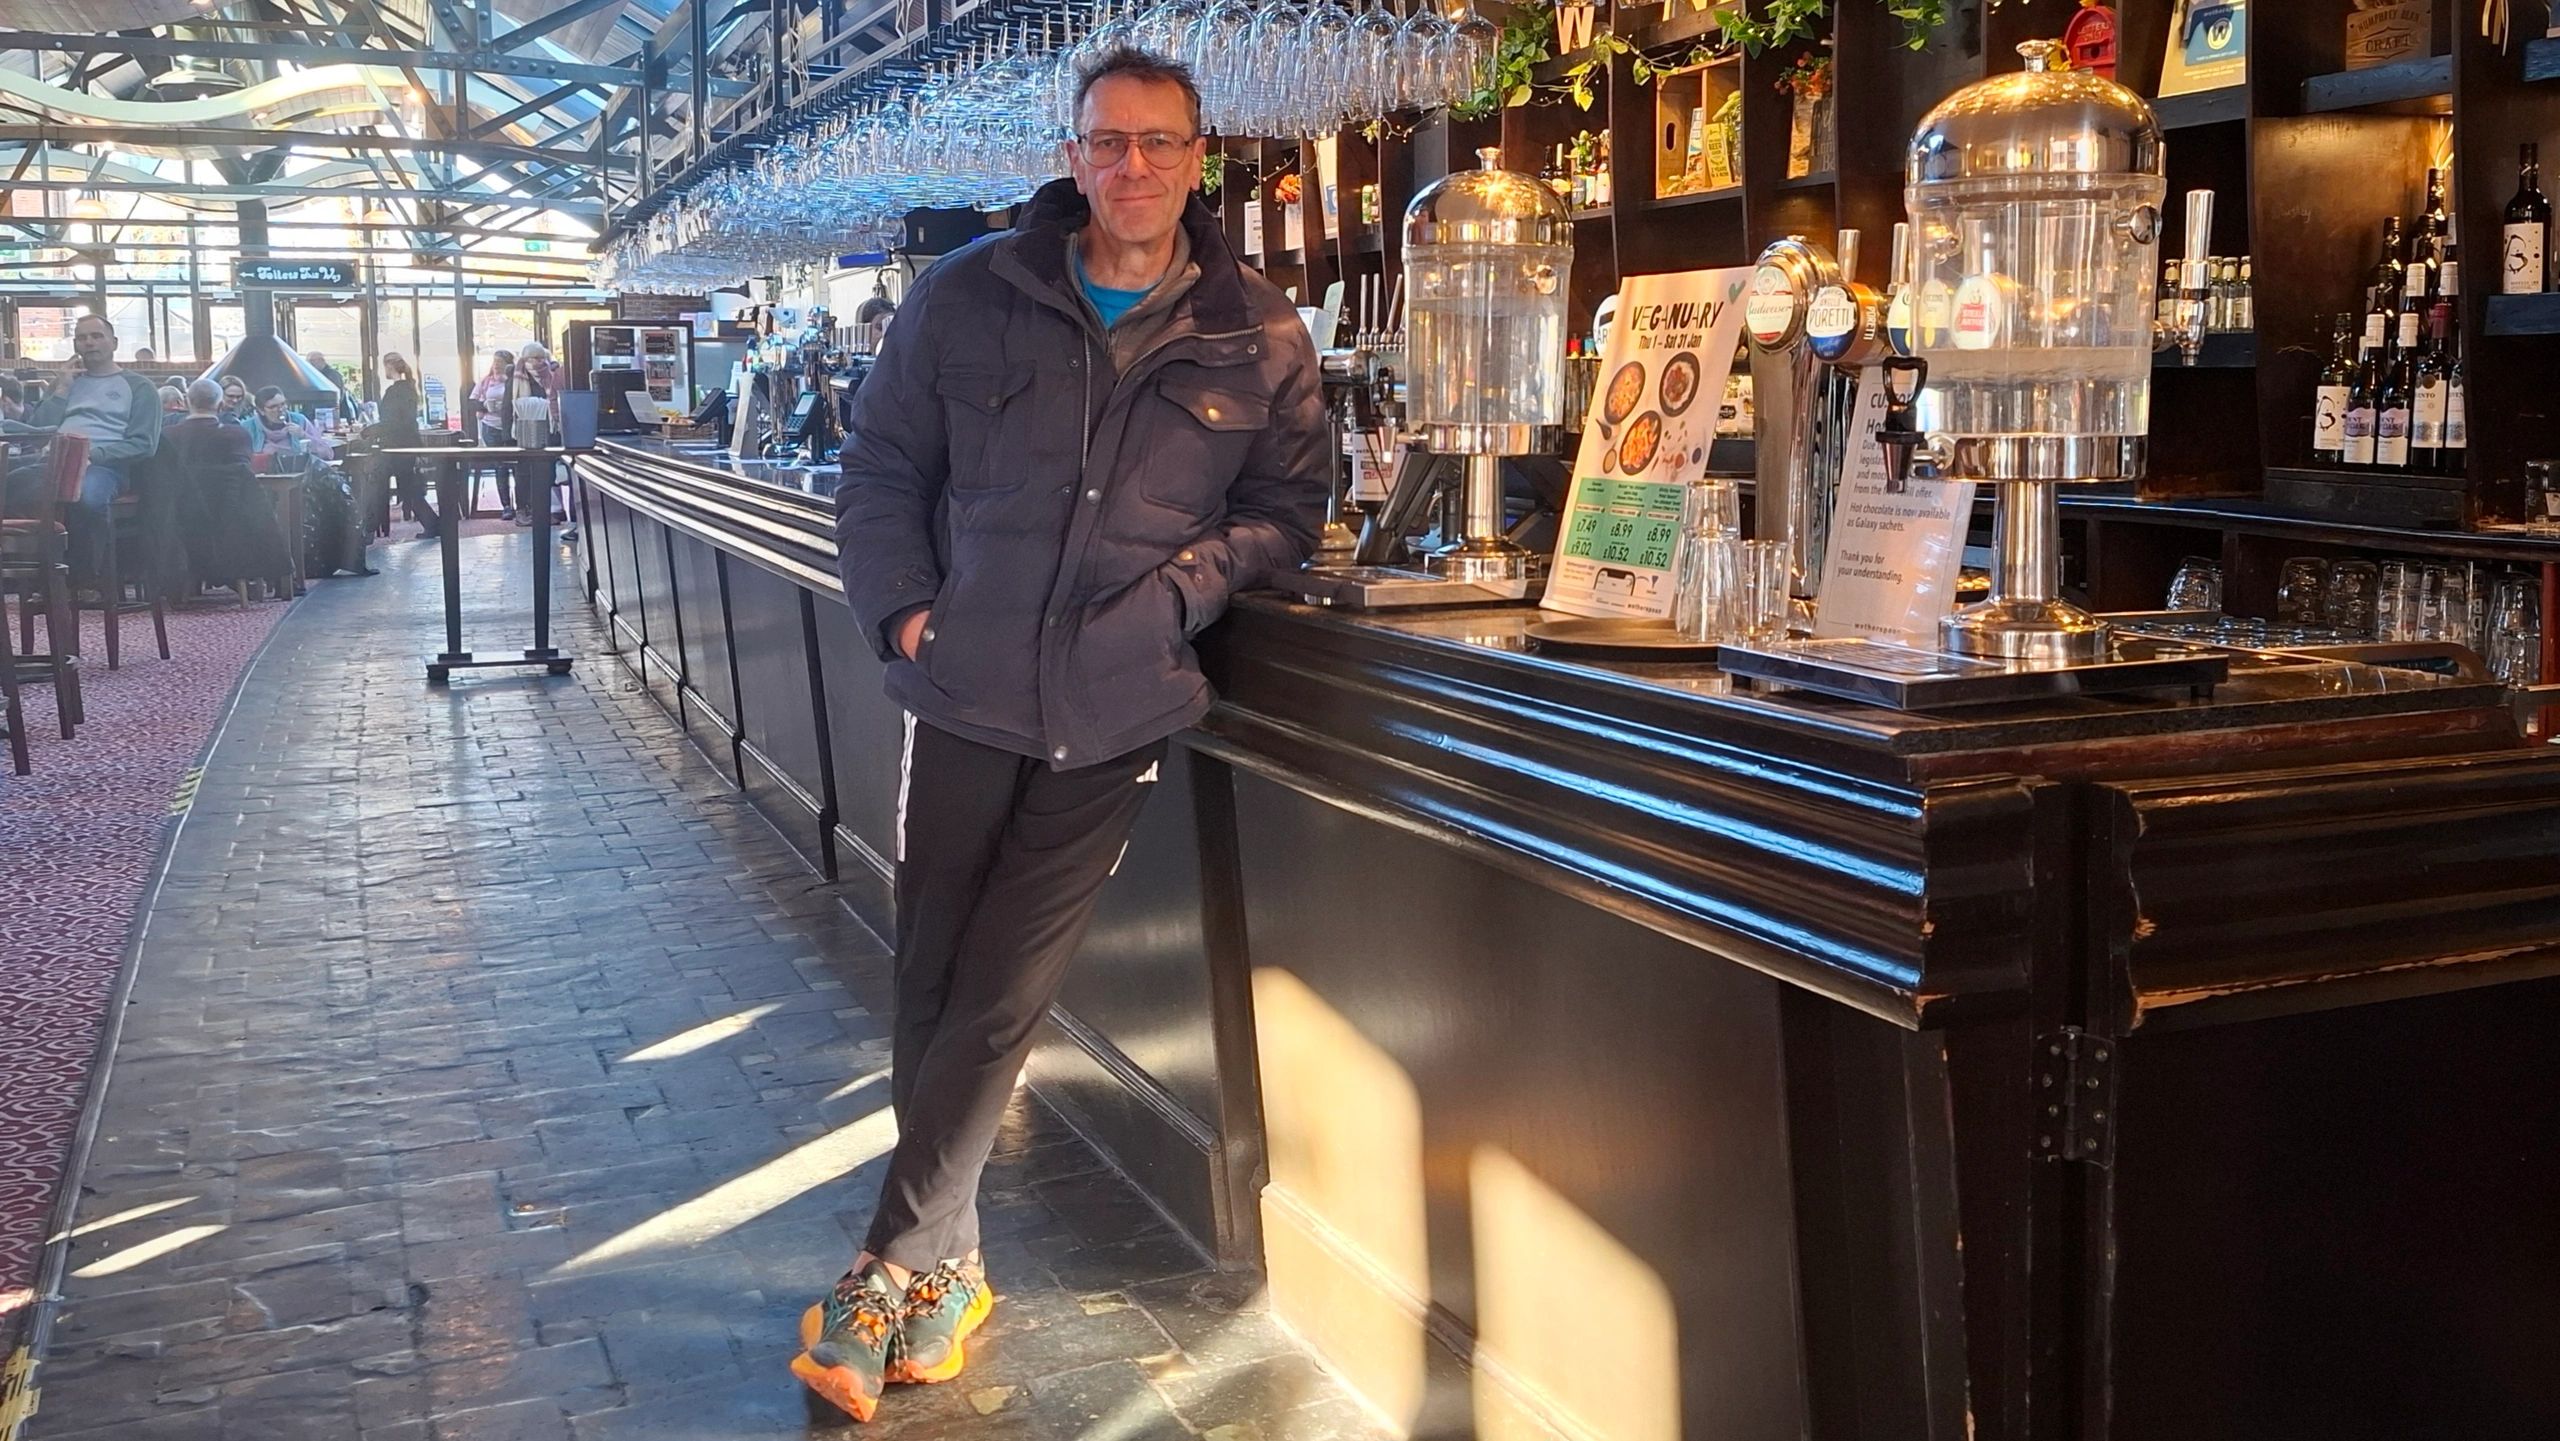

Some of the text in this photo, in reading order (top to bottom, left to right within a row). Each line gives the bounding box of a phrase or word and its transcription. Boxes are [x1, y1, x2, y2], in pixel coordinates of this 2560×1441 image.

[1631, 301, 1724, 331] VEGANUARY
[1809, 307, 1850, 328] PORETTI
[1864, 304, 1876, 341] PORETTI
[1639, 335, 1652, 350] Thu
[1664, 334, 1677, 349] Sat
[1678, 333, 1688, 349] 31
[1687, 333, 1702, 348] Jan
[1854, 482, 1870, 494] from
[1871, 483, 1883, 495] the
[1850, 503, 1863, 514] Hot
[1863, 503, 1895, 516] chocolate
[1918, 509, 1951, 521] available
[1576, 518, 1597, 534] £7.49
[1610, 522, 1633, 539] £8.99
[1847, 518, 1855, 527] as
[1855, 517, 1878, 532] Galaxy
[1647, 527, 1671, 544] £8.99
[1602, 544, 1630, 563] £10.52
[1639, 549, 1668, 568] £10.52
[1840, 549, 1885, 565] Thank you for
[1837, 567, 1853, 577] your
